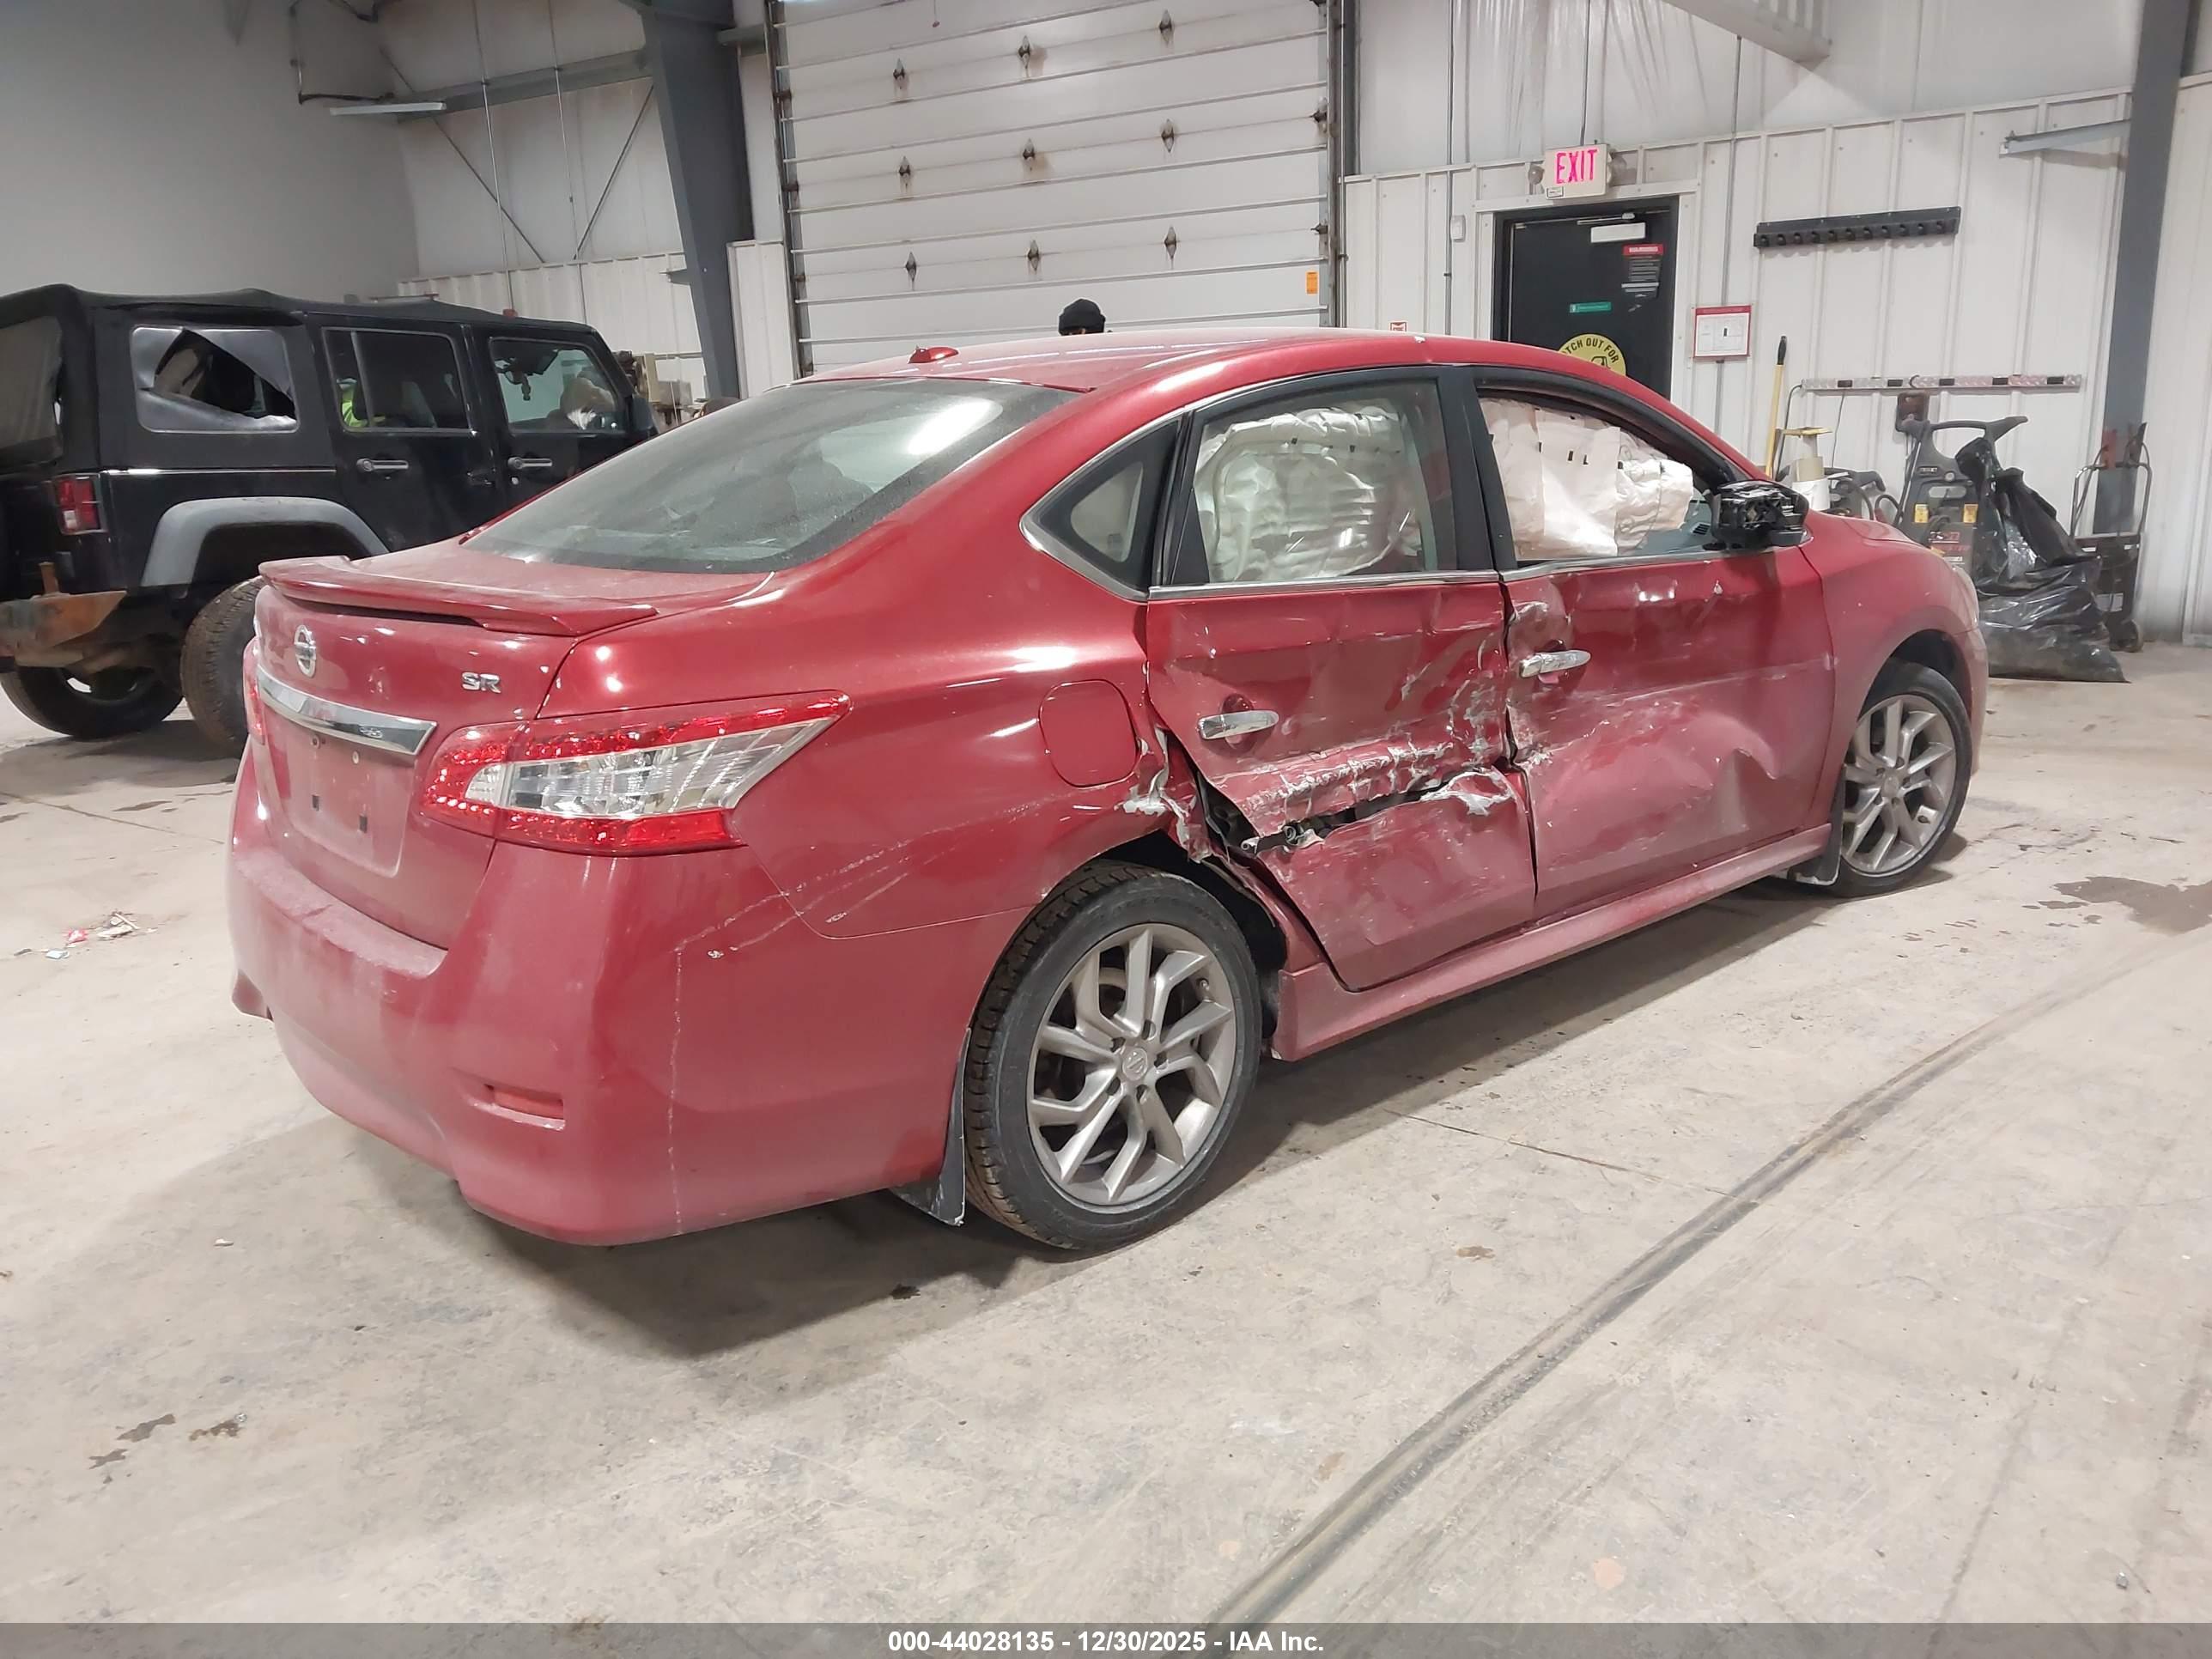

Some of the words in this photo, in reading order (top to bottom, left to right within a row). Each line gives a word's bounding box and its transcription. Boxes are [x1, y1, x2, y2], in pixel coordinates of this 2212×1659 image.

[1556, 149, 1598, 184] EXIT
[1561, 339, 1583, 354] TCH
[1585, 337, 1605, 349] OUT
[1603, 344, 1620, 363] FOR
[461, 672, 501, 694] SR
